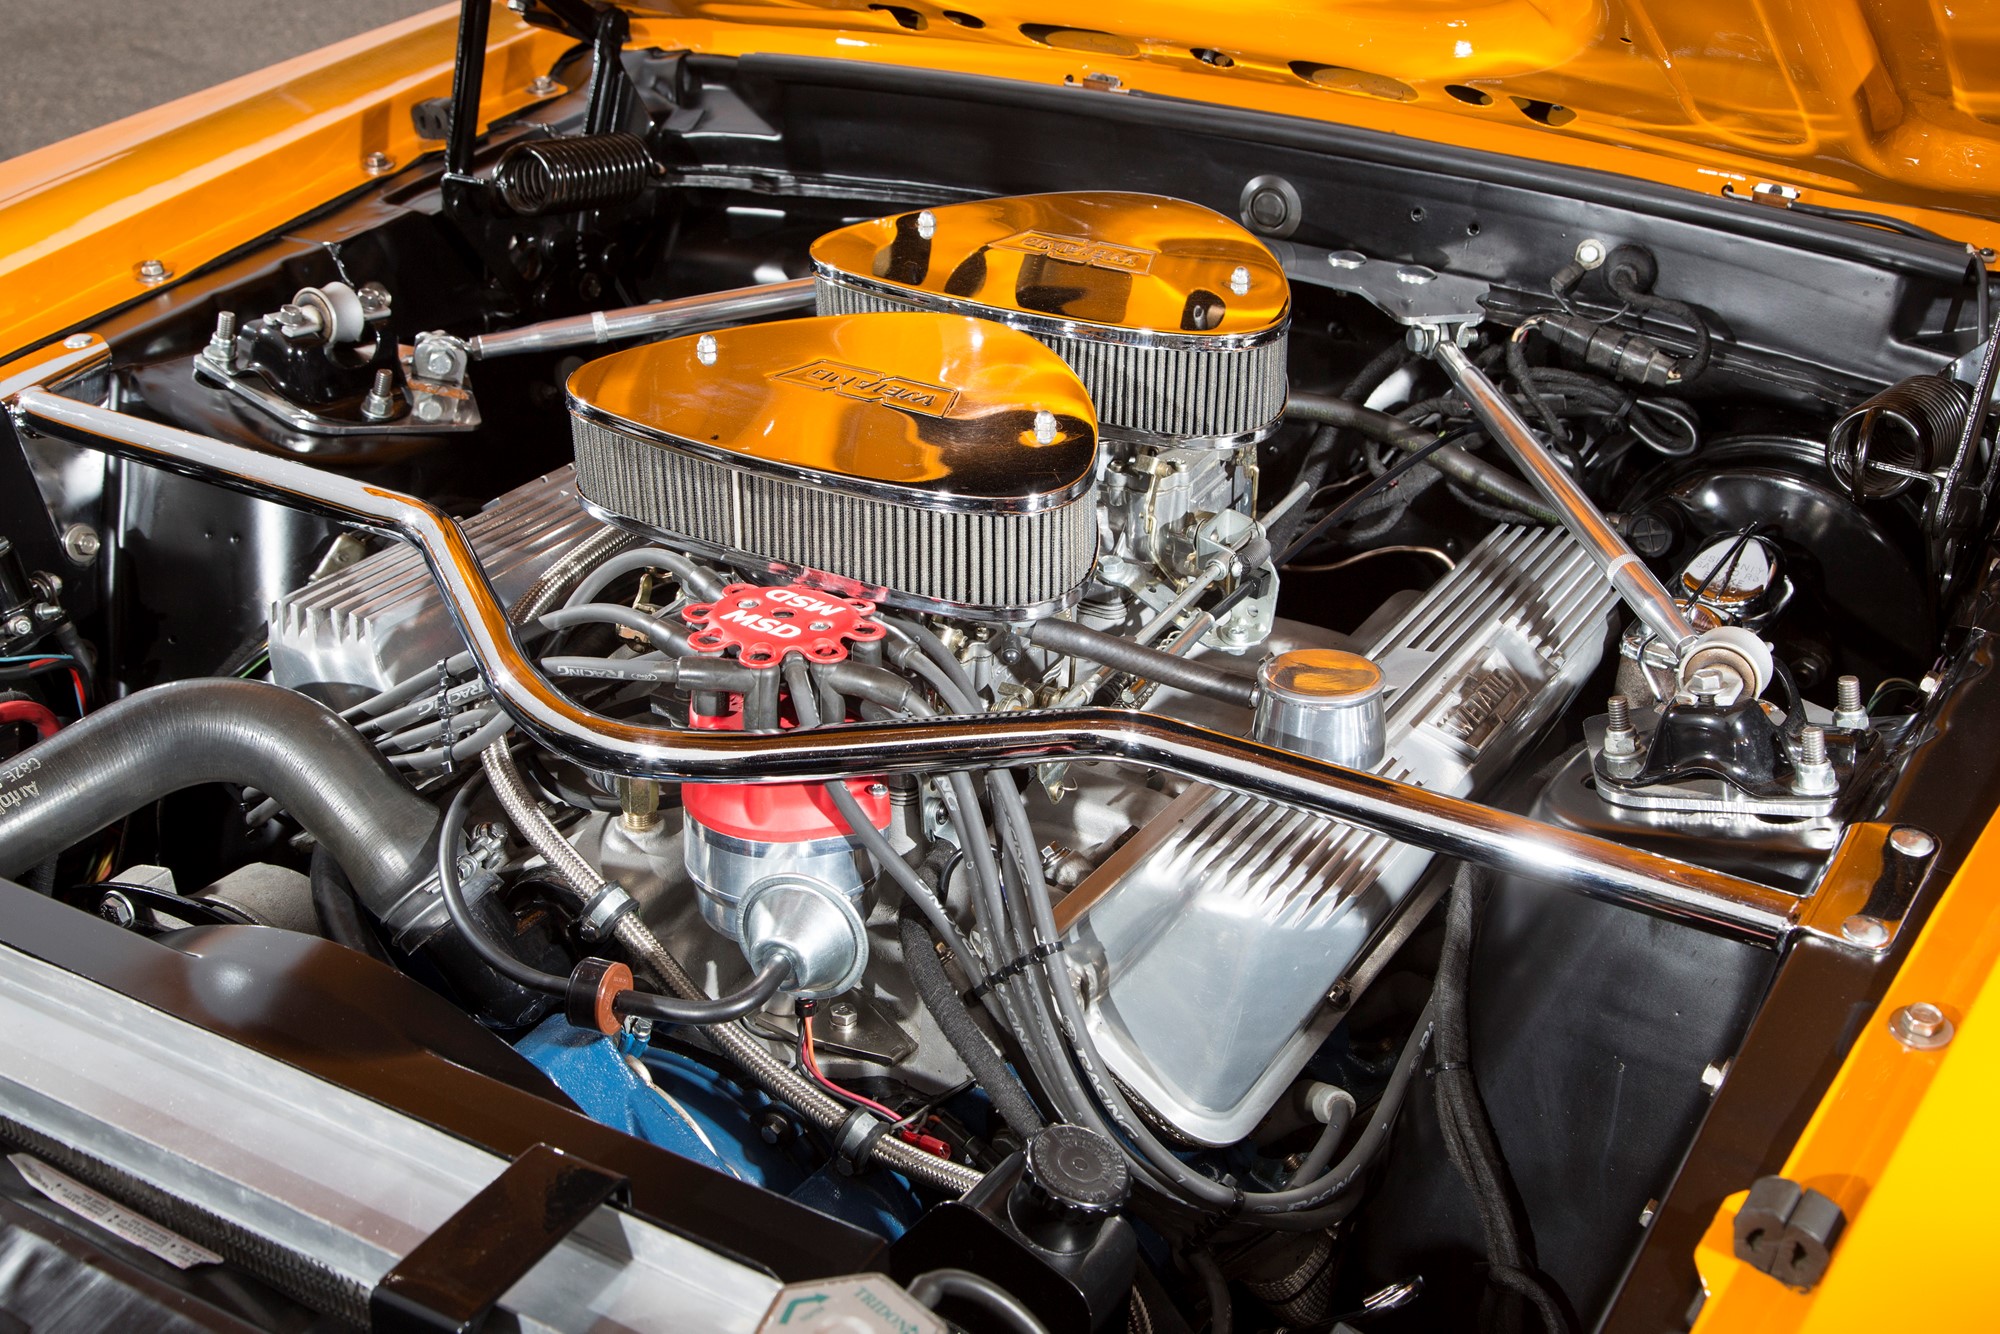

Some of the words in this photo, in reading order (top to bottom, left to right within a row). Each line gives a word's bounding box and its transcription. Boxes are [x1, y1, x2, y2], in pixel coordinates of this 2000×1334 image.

[807, 368, 937, 407] WEIAND
[765, 589, 847, 617] MSD
[720, 610, 802, 638] MSD
[558, 665, 625, 680] RACING
[1076, 1047, 1139, 1139] RACING
